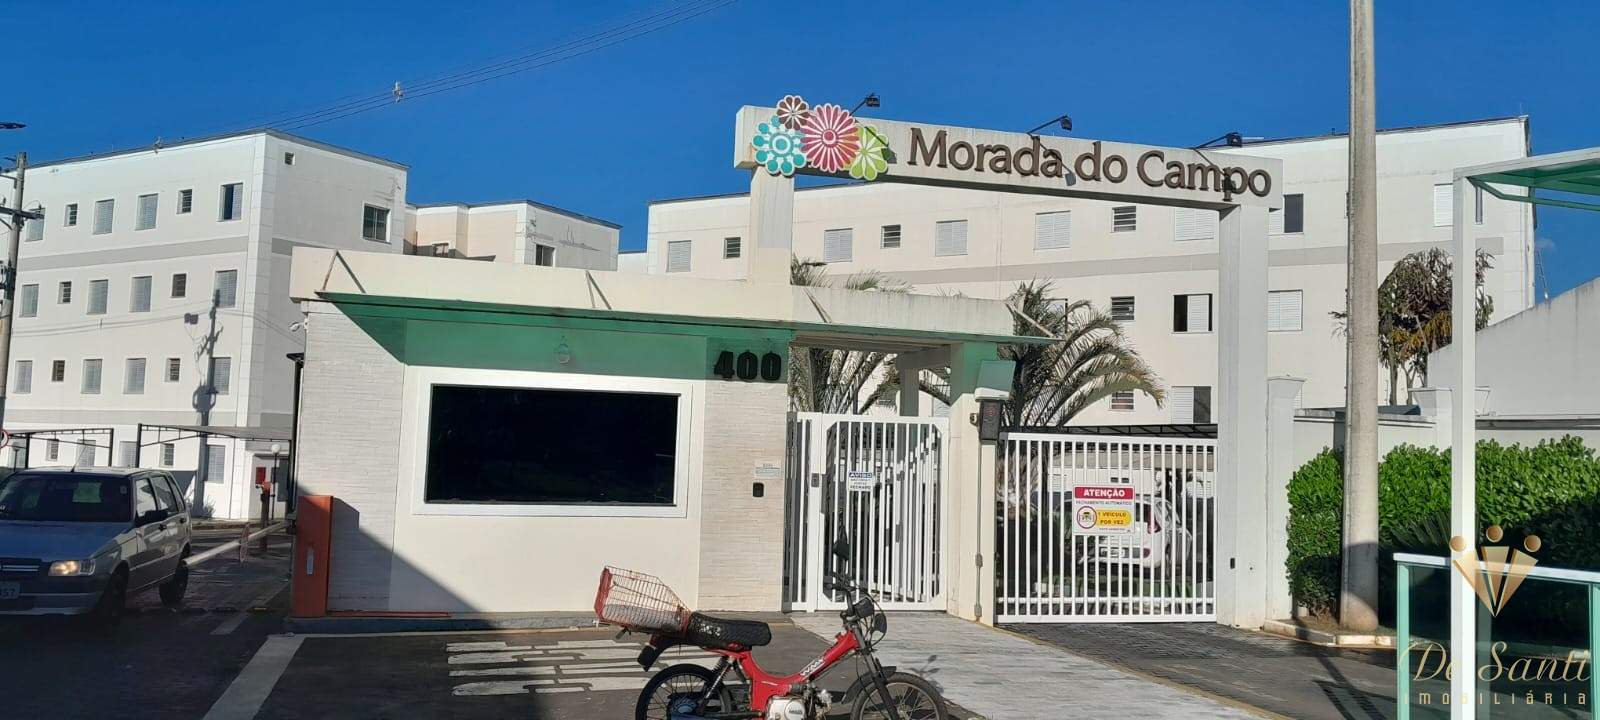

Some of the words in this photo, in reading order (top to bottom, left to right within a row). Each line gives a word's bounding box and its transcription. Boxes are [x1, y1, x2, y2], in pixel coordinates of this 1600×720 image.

[907, 127, 1063, 178] Morada
[1074, 141, 1128, 183] do
[1137, 150, 1272, 202] Campo
[714, 350, 782, 380] 400
[1083, 488, 1126, 498] ATENÇÃO
